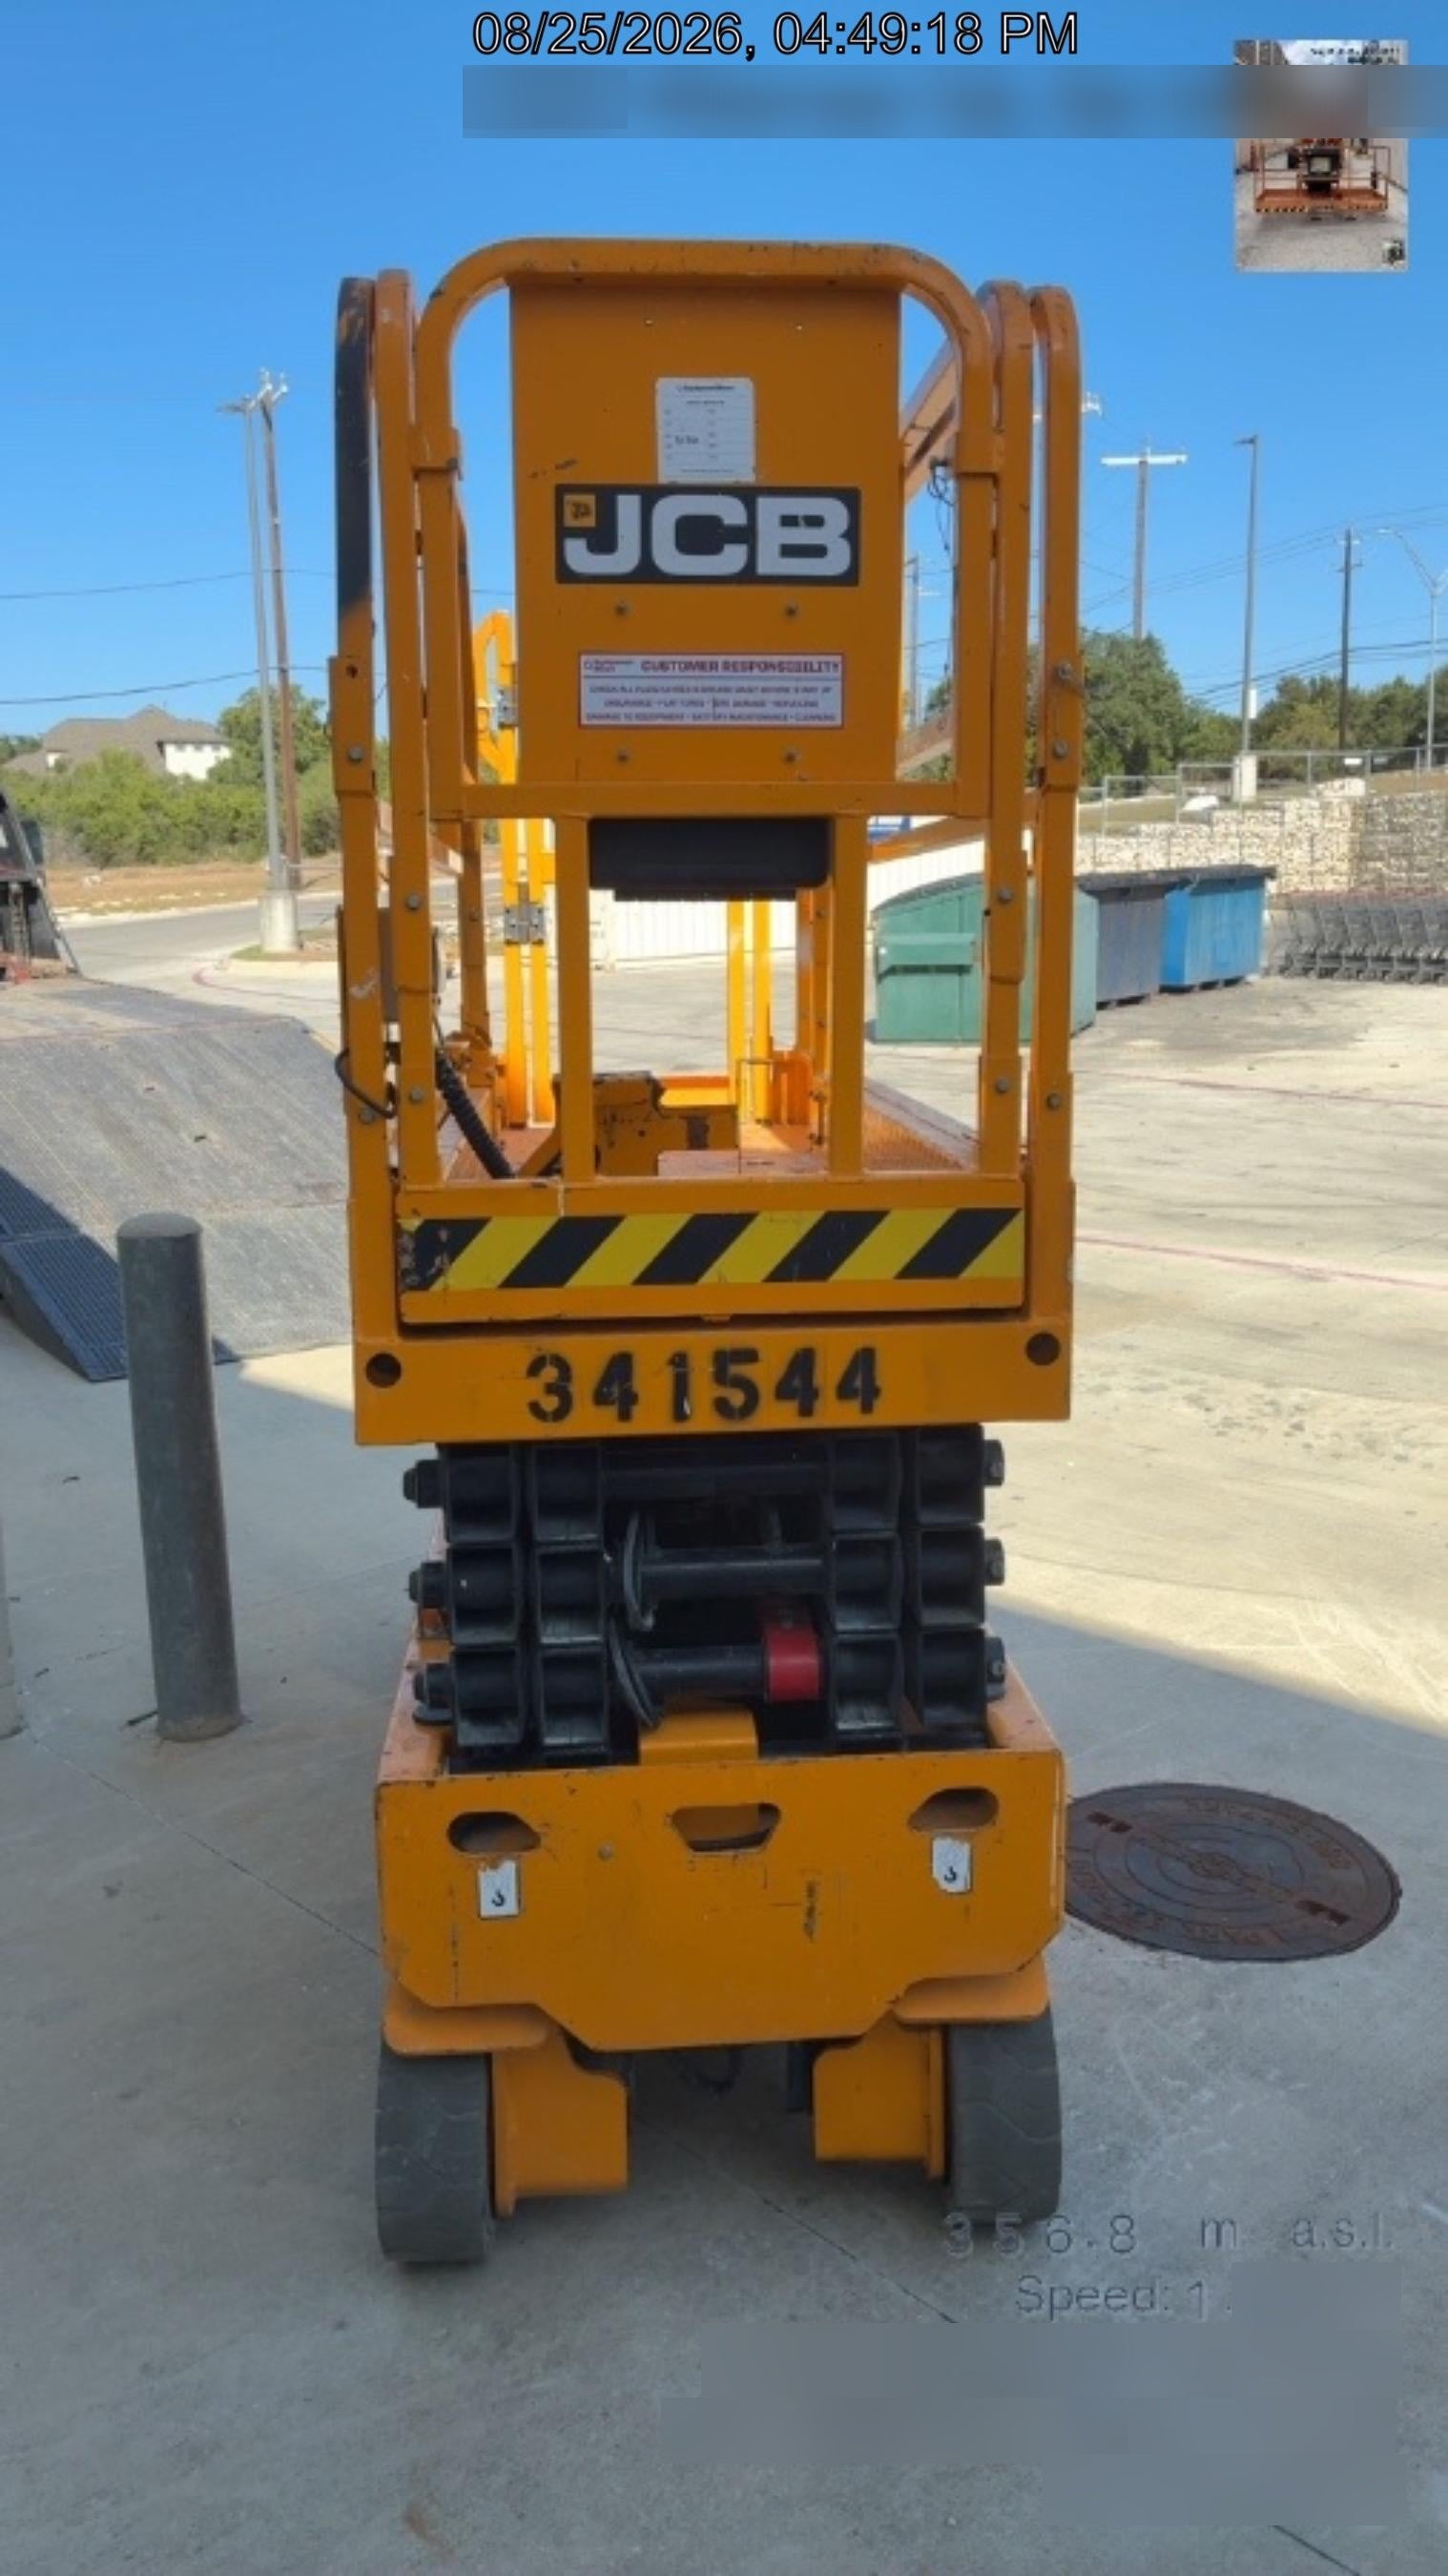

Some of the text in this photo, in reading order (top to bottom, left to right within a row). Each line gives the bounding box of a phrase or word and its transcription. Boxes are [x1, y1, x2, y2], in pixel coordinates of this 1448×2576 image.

[564, 493, 852, 576] JCB
[640, 659, 719, 673] CUSTOMER
[721, 659, 840, 674] RESPONSIBILITY
[526, 1346, 882, 1423] 341544
